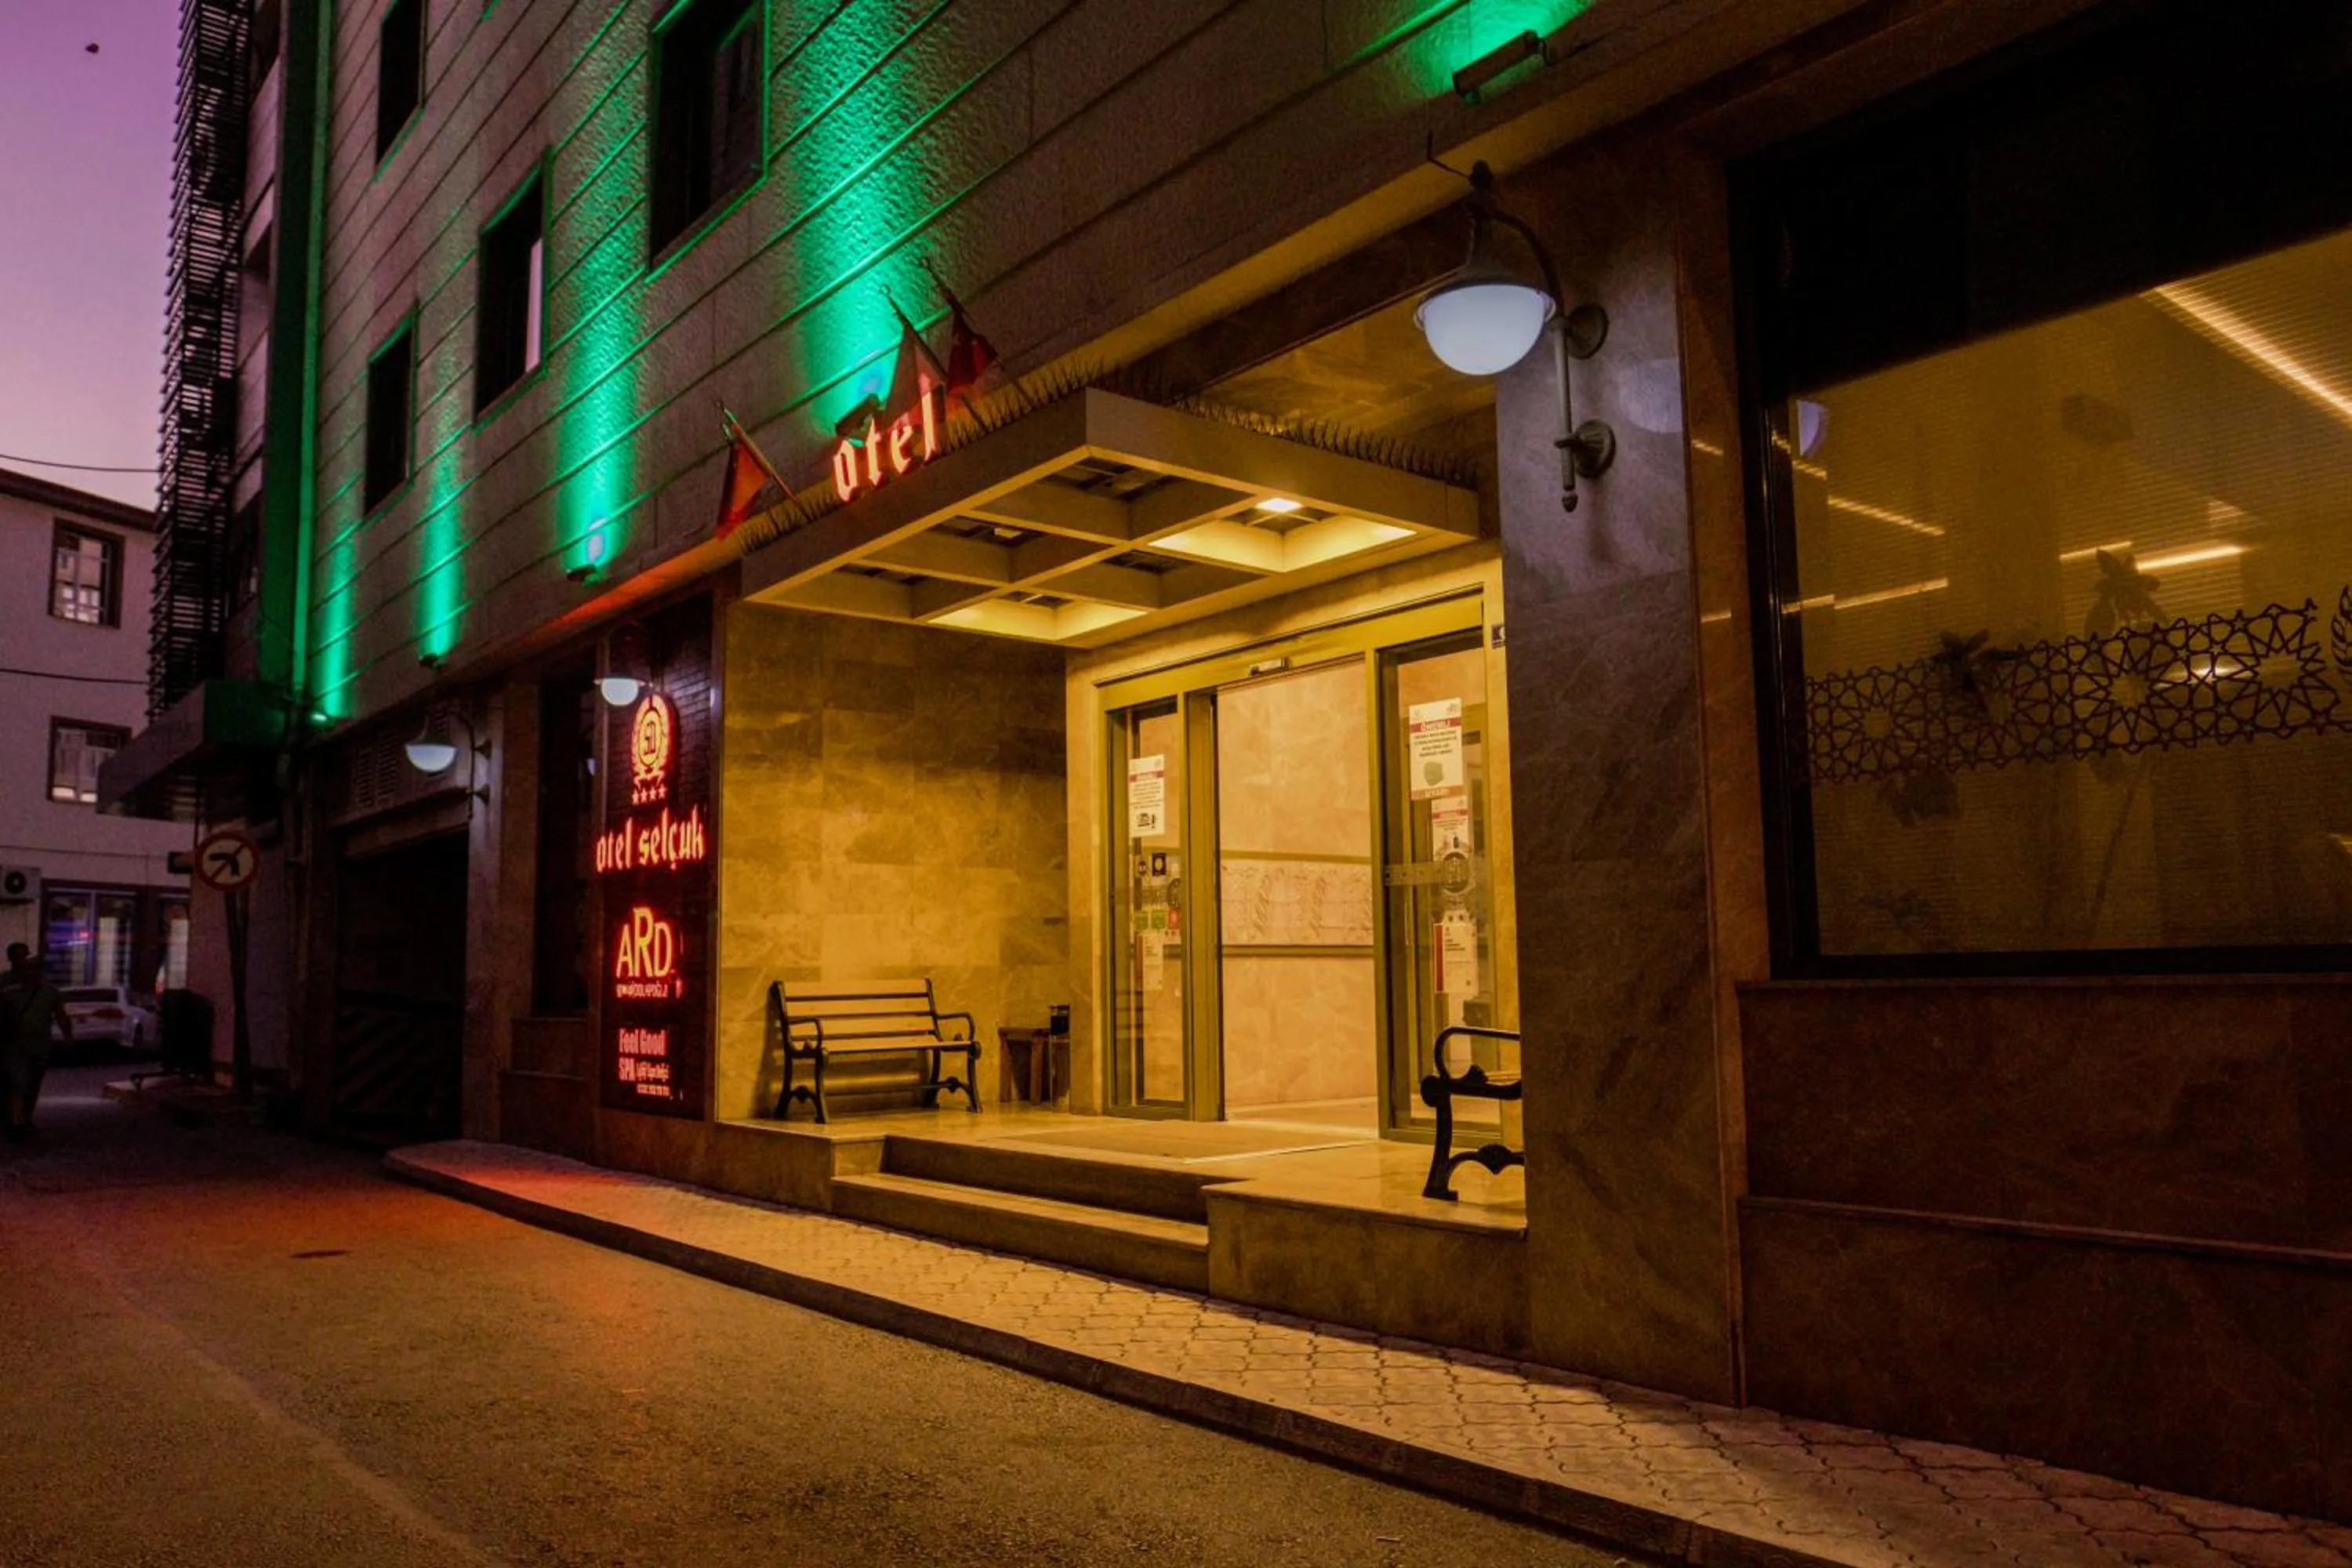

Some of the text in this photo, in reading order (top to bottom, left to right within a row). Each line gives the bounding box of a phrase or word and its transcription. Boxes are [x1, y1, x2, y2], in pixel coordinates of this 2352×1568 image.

[833, 388, 938, 502] otel
[596, 803, 705, 873] otel selçuk
[615, 906, 673, 978] ARD
[619, 1028, 666, 1056] Feel Good
[619, 1057, 635, 1082] SPA
